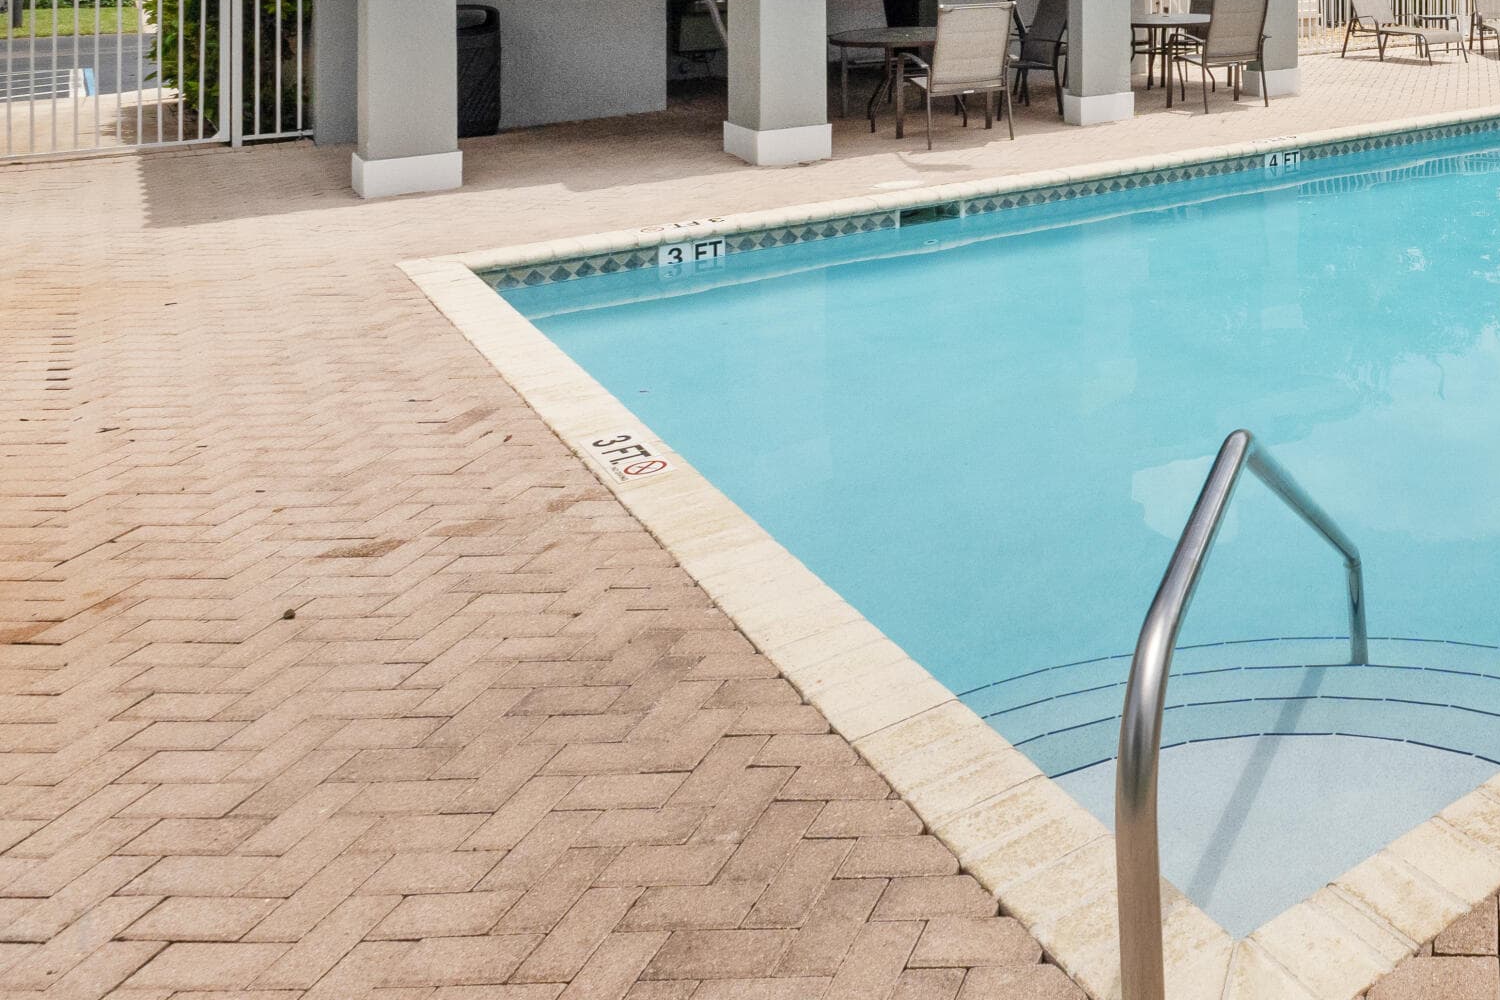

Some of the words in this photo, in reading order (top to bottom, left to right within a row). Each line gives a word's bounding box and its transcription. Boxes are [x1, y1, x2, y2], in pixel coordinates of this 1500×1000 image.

[1269, 154, 1278, 167] 4
[1284, 151, 1299, 165] FT
[667, 247, 684, 265] 3
[695, 240, 723, 260] FT
[592, 434, 632, 448] 3
